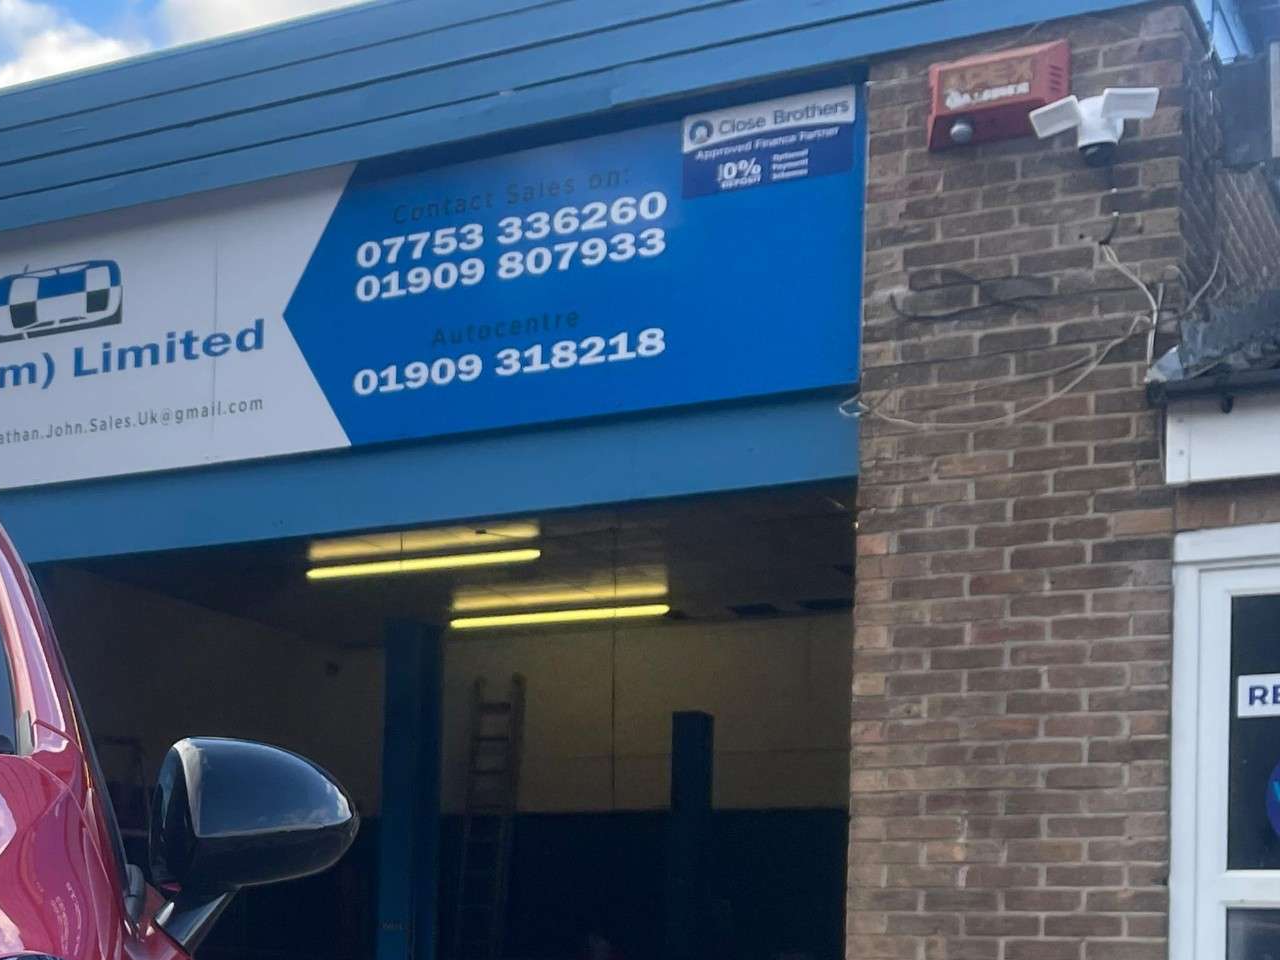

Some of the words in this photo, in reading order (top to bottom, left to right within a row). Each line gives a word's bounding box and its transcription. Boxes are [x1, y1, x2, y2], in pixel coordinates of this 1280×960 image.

[718, 116, 766, 135] Close
[773, 100, 849, 124] Brothers
[393, 192, 495, 224] Contact
[507, 171, 576, 204] Sales
[588, 166, 631, 190] on:
[356, 223, 484, 268] 07753
[496, 190, 668, 244] 336260
[355, 258, 485, 302] 01909
[496, 227, 667, 280] 807933
[73, 318, 265, 378] Limited
[431, 309, 580, 347] Autocentre
[353, 354, 483, 395] 01909
[495, 327, 666, 377] 318218
